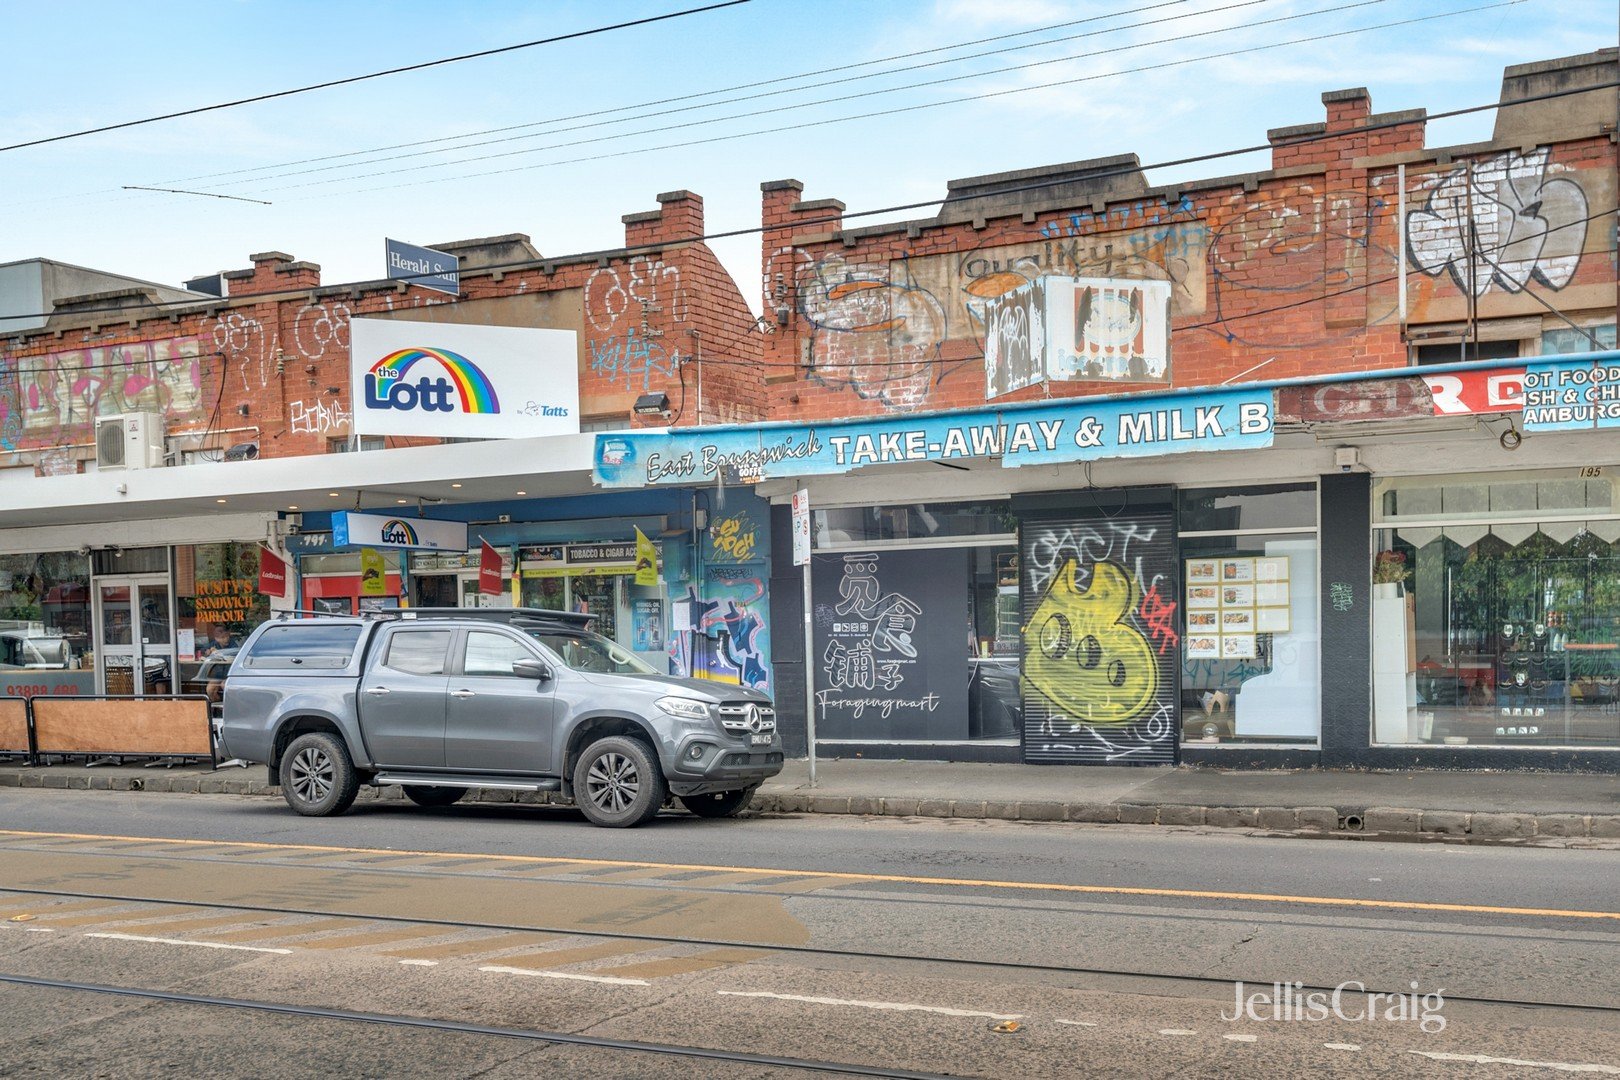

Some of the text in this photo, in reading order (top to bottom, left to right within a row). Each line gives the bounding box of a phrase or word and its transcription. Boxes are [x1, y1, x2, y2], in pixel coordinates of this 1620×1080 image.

[390, 251, 457, 283] Herald Sun
[378, 367, 398, 378] the
[1559, 366, 1620, 386] FOOD
[364, 373, 454, 412] Lott
[1562, 387, 1580, 404] &
[541, 405, 569, 417] Tatts
[646, 402, 1274, 482] East Brunswick TAKE-AWAY & MILK B
[1580, 467, 1602, 478] 195
[381, 529, 407, 544] Lott
[570, 548, 598, 559] TOBACCO
[599, 549, 605, 558] &
[605, 547, 625, 558] CIGAR
[262, 571, 284, 580] Ladbrokes
[196, 579, 253, 595] RUSTY'S
[195, 596, 253, 609] SANDWICH
[196, 610, 245, 622] PARLOUR
